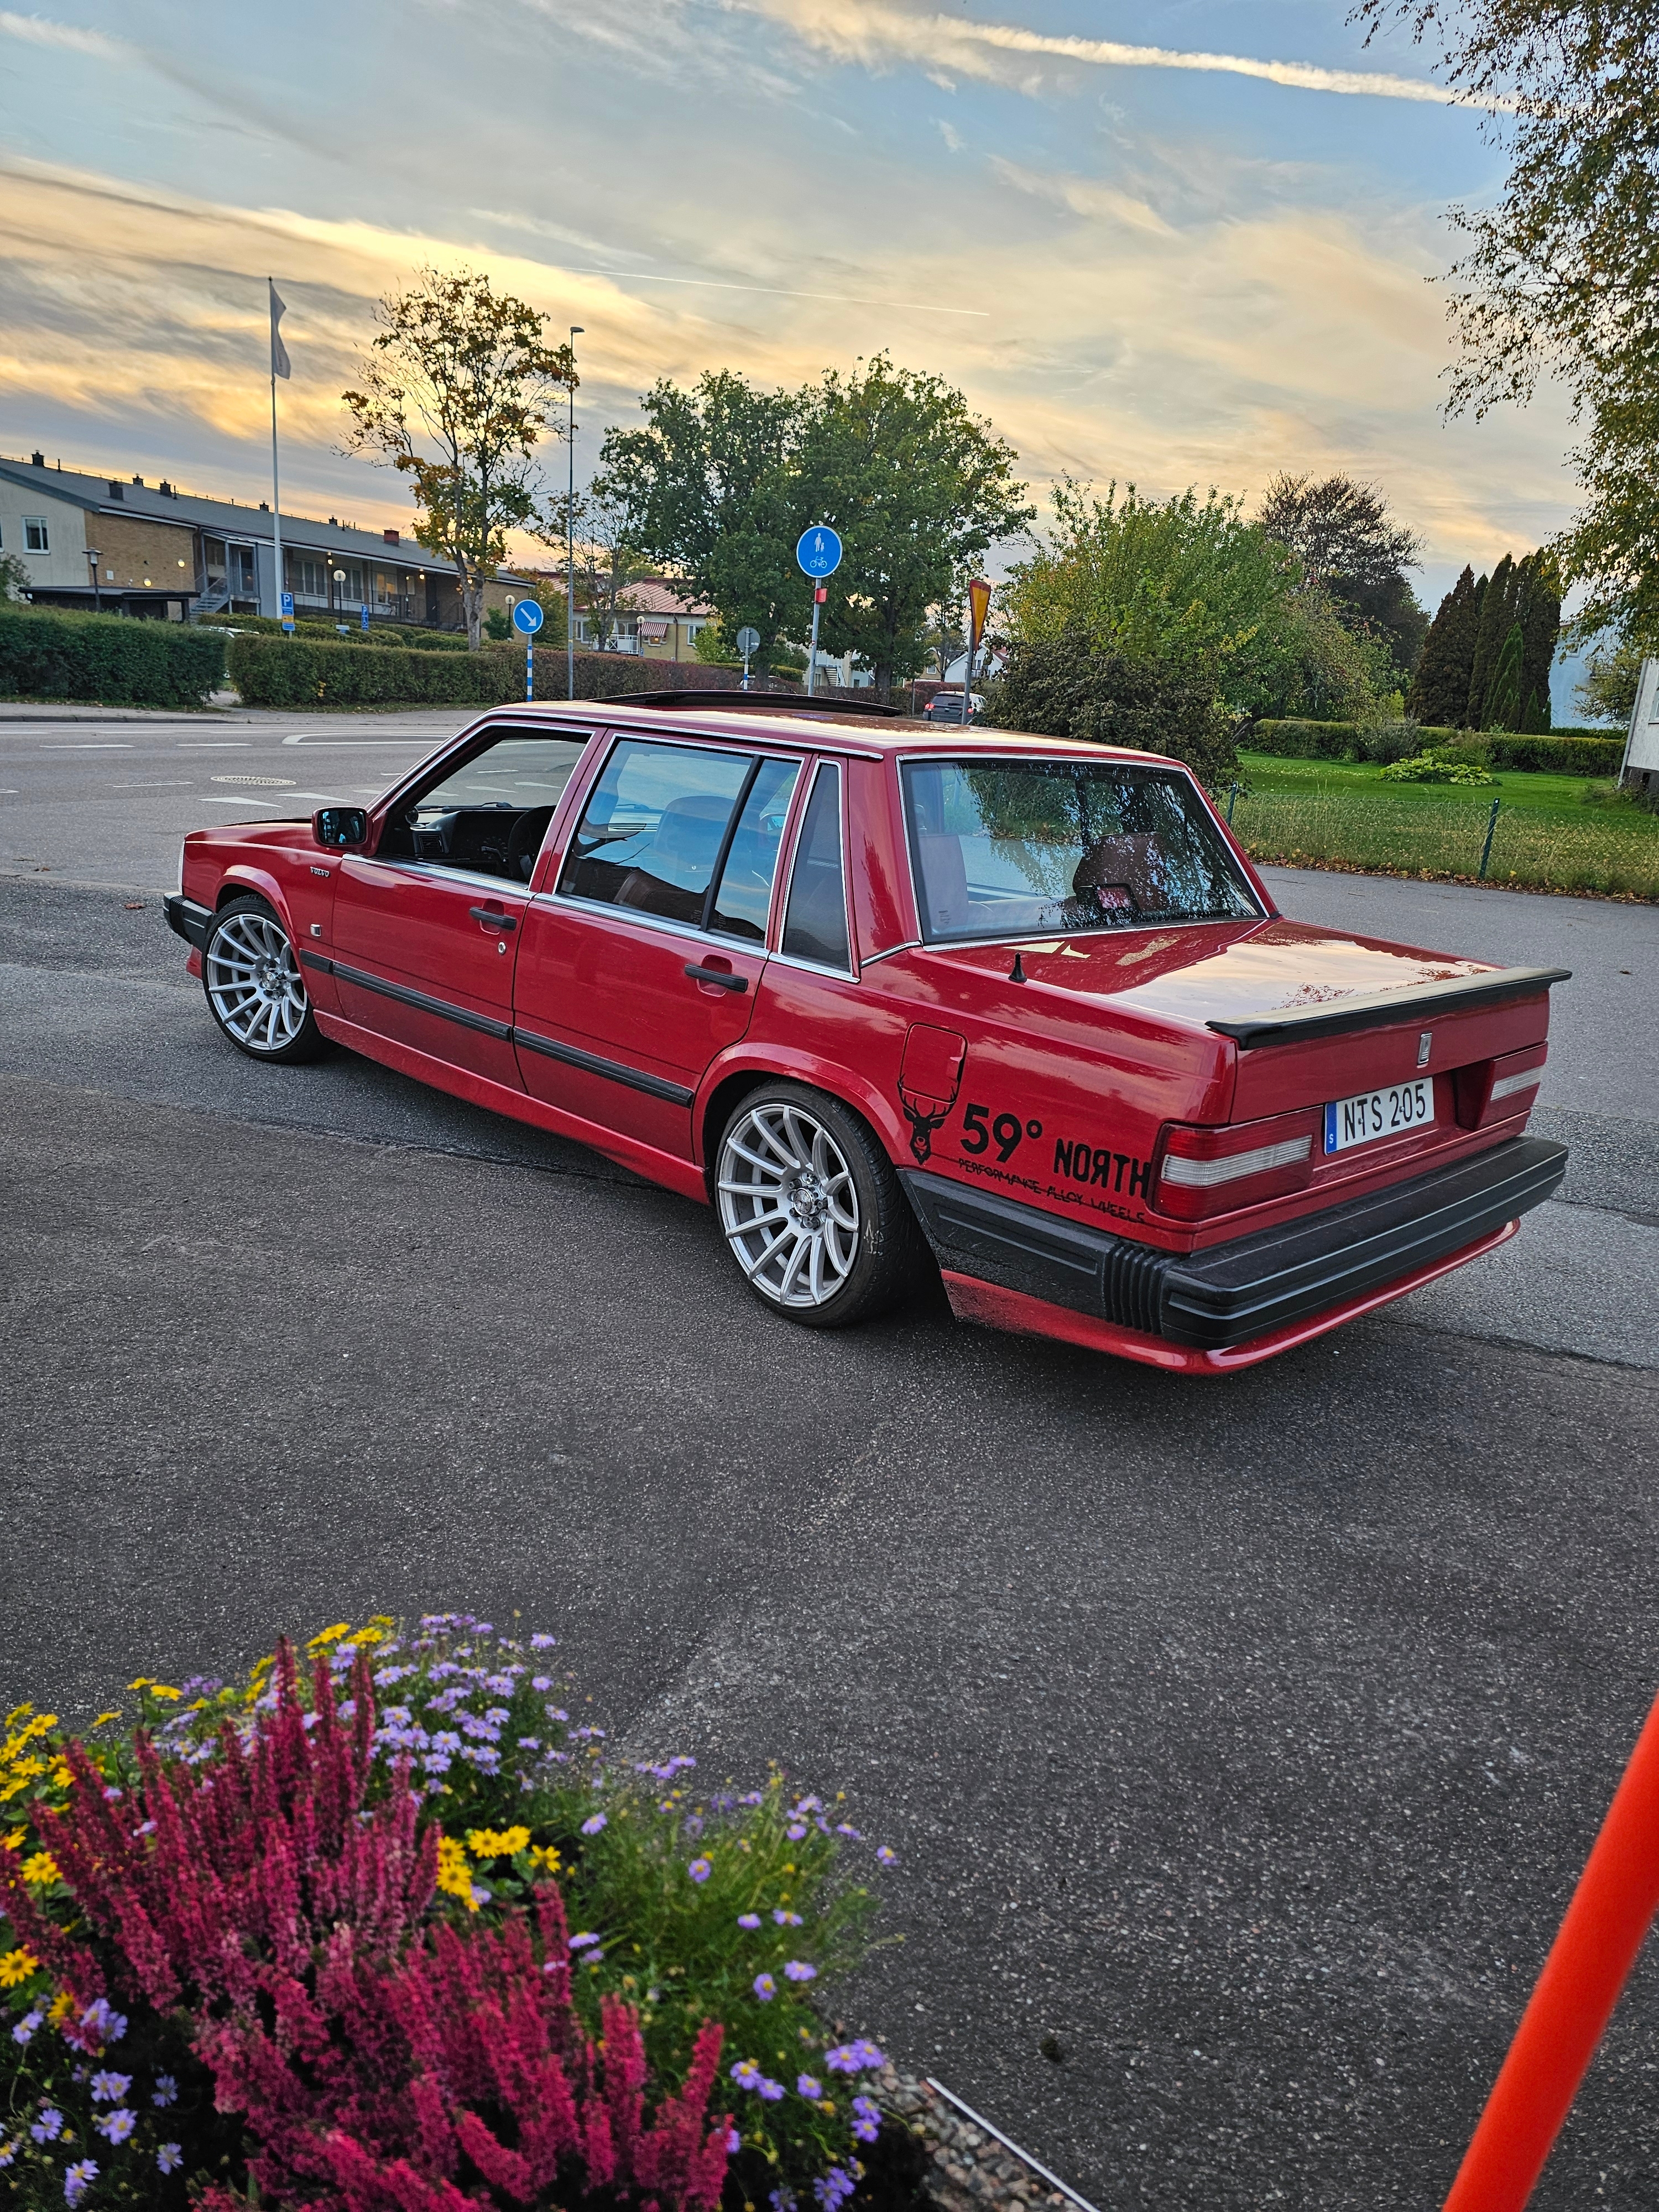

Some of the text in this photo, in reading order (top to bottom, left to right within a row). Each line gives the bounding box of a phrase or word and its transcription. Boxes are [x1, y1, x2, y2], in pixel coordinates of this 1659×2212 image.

[283, 594, 290, 606] P
[310, 867, 329, 877] VOLVO
[1344, 1083, 1426, 1141] NTS 205
[1329, 1134, 1334, 1144] S
